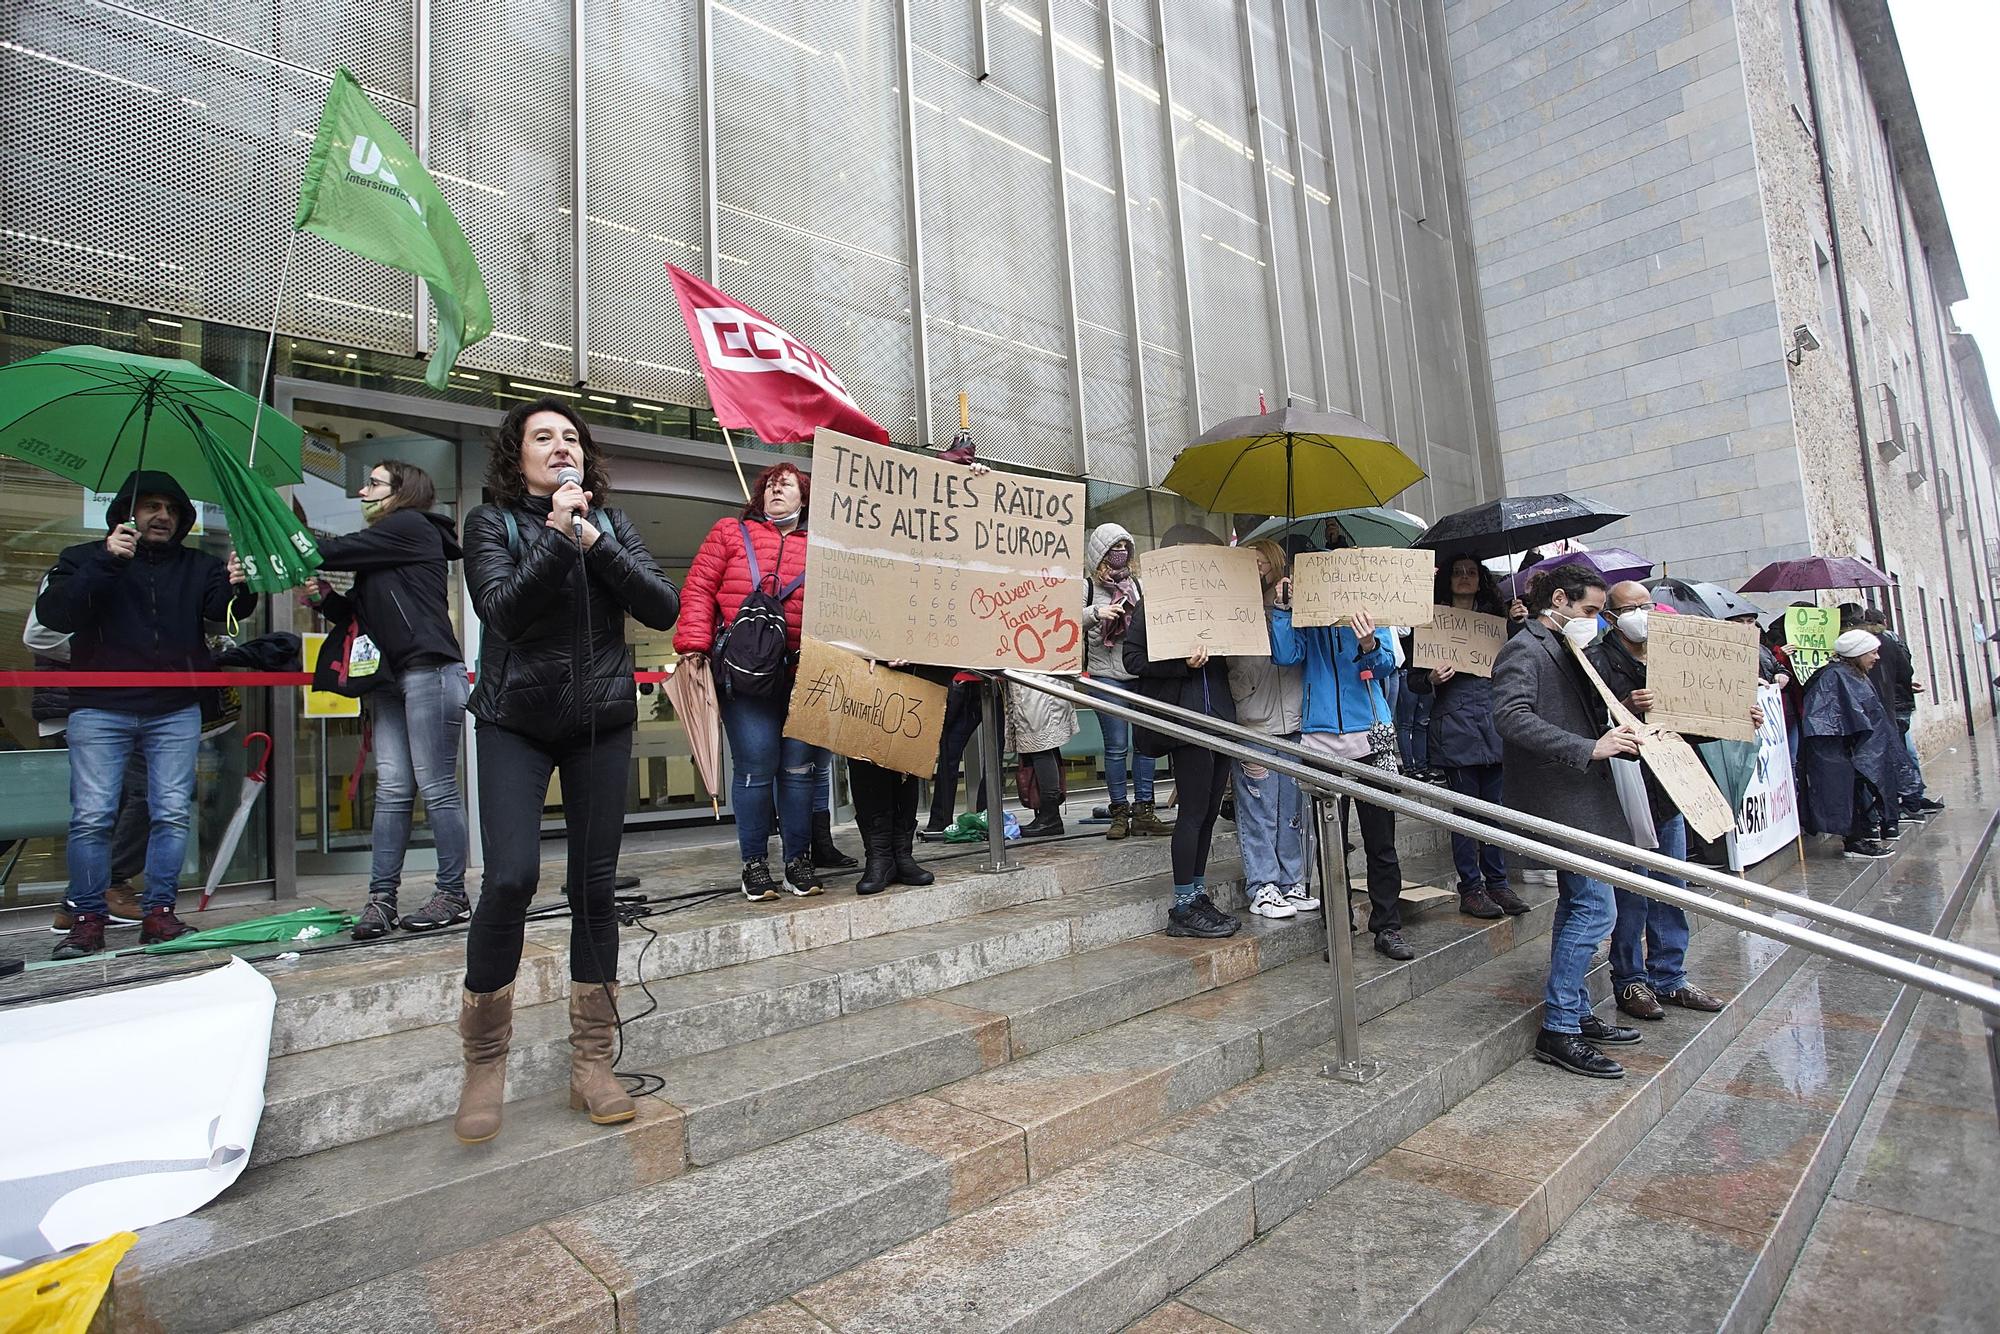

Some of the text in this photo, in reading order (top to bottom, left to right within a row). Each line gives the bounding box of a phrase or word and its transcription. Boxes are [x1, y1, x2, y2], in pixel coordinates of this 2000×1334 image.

[831, 445, 1074, 526] TENIM LES RÀTIOS
[830, 492, 1071, 560] MÉS ALTES D'EUROPA
[819, 560, 958, 591] HOLANDA 4 5 6
[1148, 560, 1220, 577] MATEIXA
[1180, 578, 1228, 591] FEINA
[1403, 575, 1413, 585] A
[819, 581, 956, 611] ITALIA 6 6 6
[1306, 591, 1417, 604] LA PATRONAL
[819, 600, 958, 628] PORTUGAL 4 5 15
[999, 595, 1048, 630] també
[1152, 607, 1256, 625] MATEIX SOU
[1797, 608, 1829, 626] 0-3
[1433, 614, 1468, 631] ATEIXA
[815, 622, 881, 641] CATALUNYA
[906, 629, 914, 645] 8
[943, 633, 960, 648] 20
[996, 607, 1079, 664] al 0-3
[1197, 628, 1212, 640] €
[1794, 634, 1827, 648] VAGA
[1470, 650, 1492, 667] SOU
[1792, 650, 1808, 665] EL
[1680, 671, 1746, 697] DIGNE
